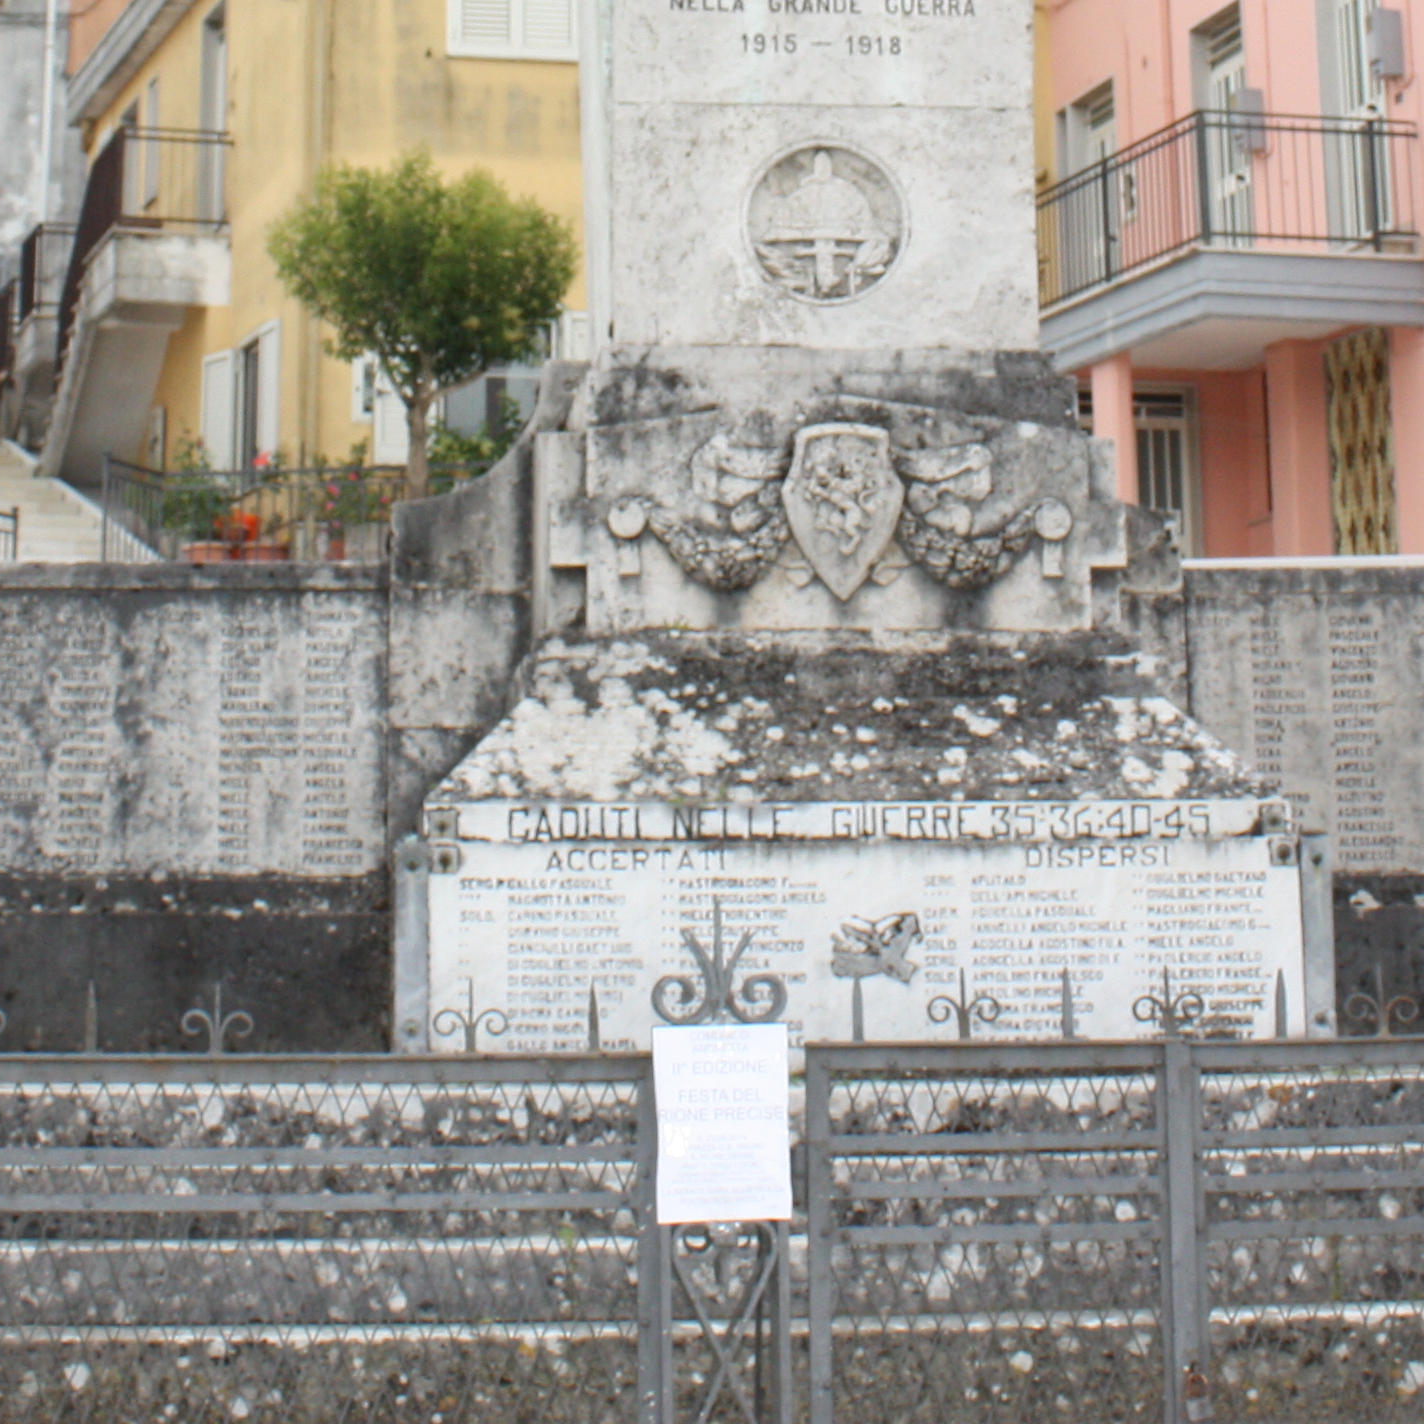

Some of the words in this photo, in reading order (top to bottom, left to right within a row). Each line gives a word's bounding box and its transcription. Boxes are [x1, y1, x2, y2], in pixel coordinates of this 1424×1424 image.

[741, 33, 798, 54] 1915
[845, 35, 903, 56] 1918
[507, 806, 642, 843] CADUTI
[671, 805, 794, 841] NELLE
[832, 804, 977, 840] GUERRE
[546, 848, 727, 873] ACCERTATI
[1025, 844, 1169, 868] DISPERSI
[692, 1059, 767, 1075] EDIZIONE
[678, 1088, 729, 1104] FESTA
[733, 1087, 764, 1102] DEL
